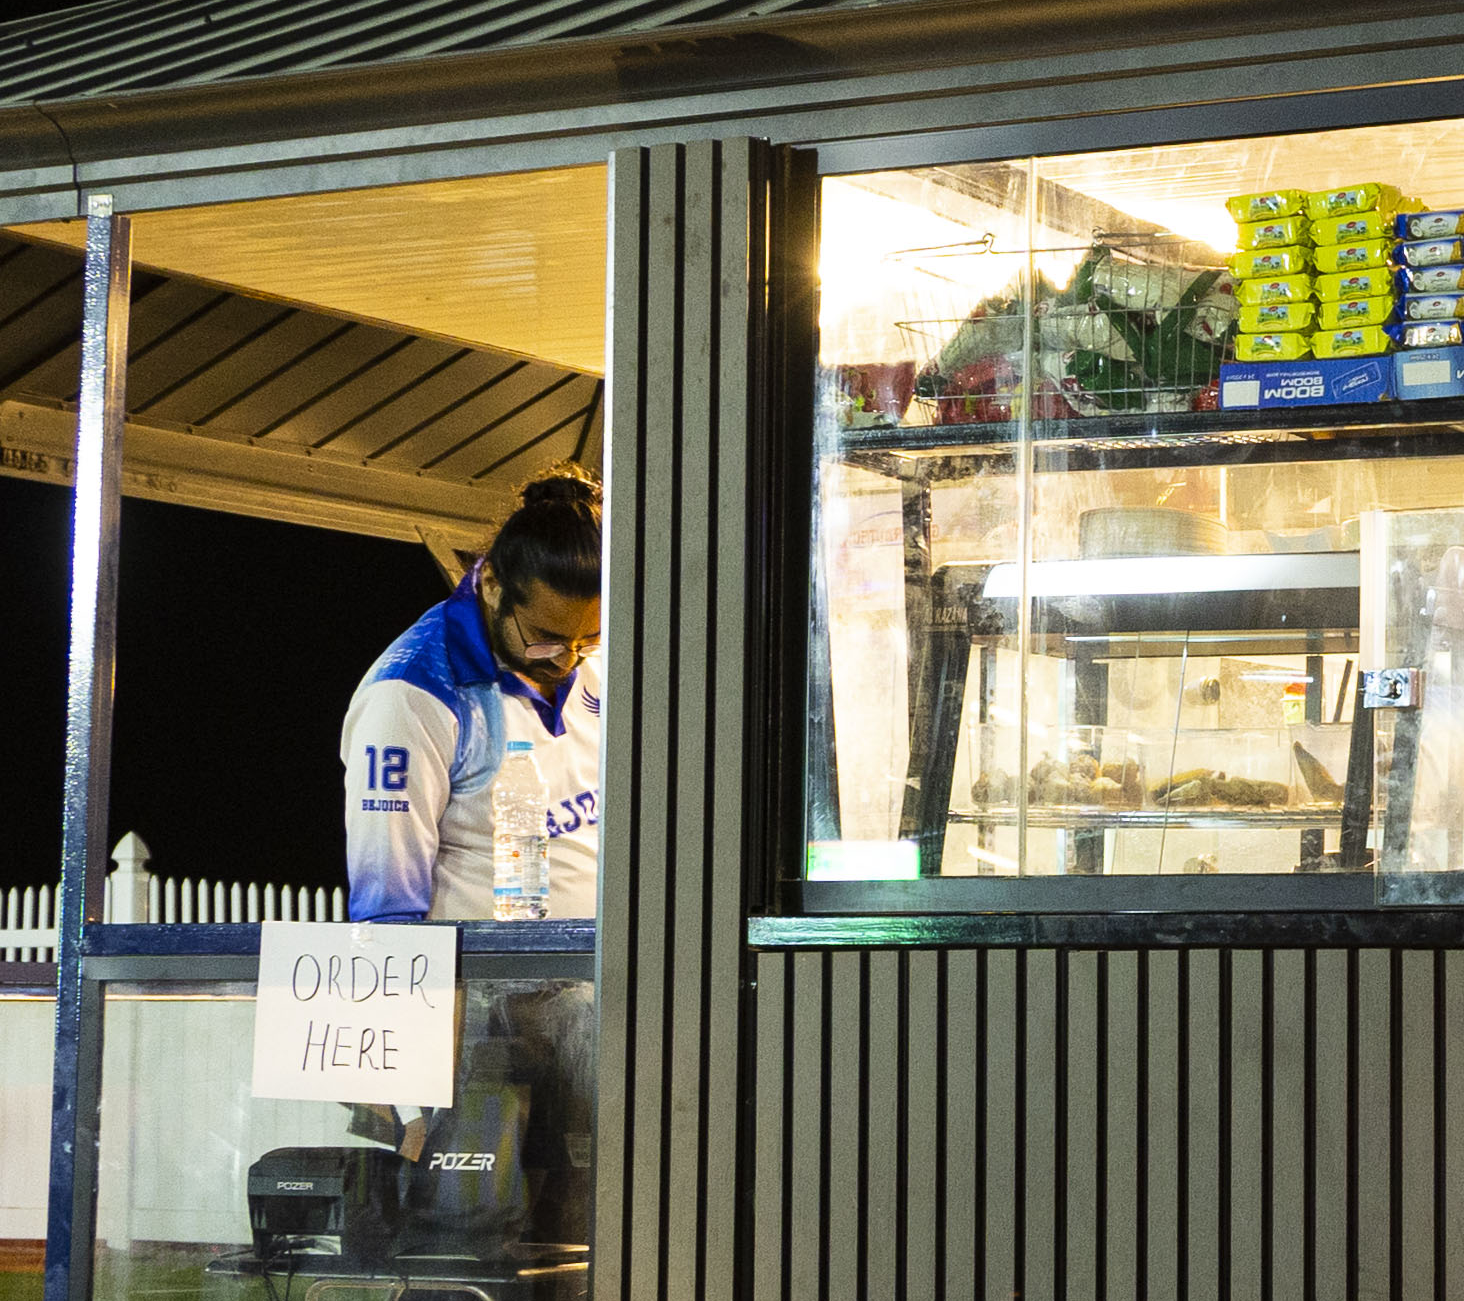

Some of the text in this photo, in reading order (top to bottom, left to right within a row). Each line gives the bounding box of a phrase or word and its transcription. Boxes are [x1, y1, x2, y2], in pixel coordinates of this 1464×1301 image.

[1280, 376, 1324, 386] BOOM
[1264, 385, 1325, 400] BOOM
[365, 744, 410, 792] 12
[362, 799, 410, 812] BEJOICE
[291, 952, 436, 1010] ORDER
[302, 1020, 398, 1072] HERE
[428, 1152, 496, 1171] POZER
[277, 1182, 313, 1190] POZER
